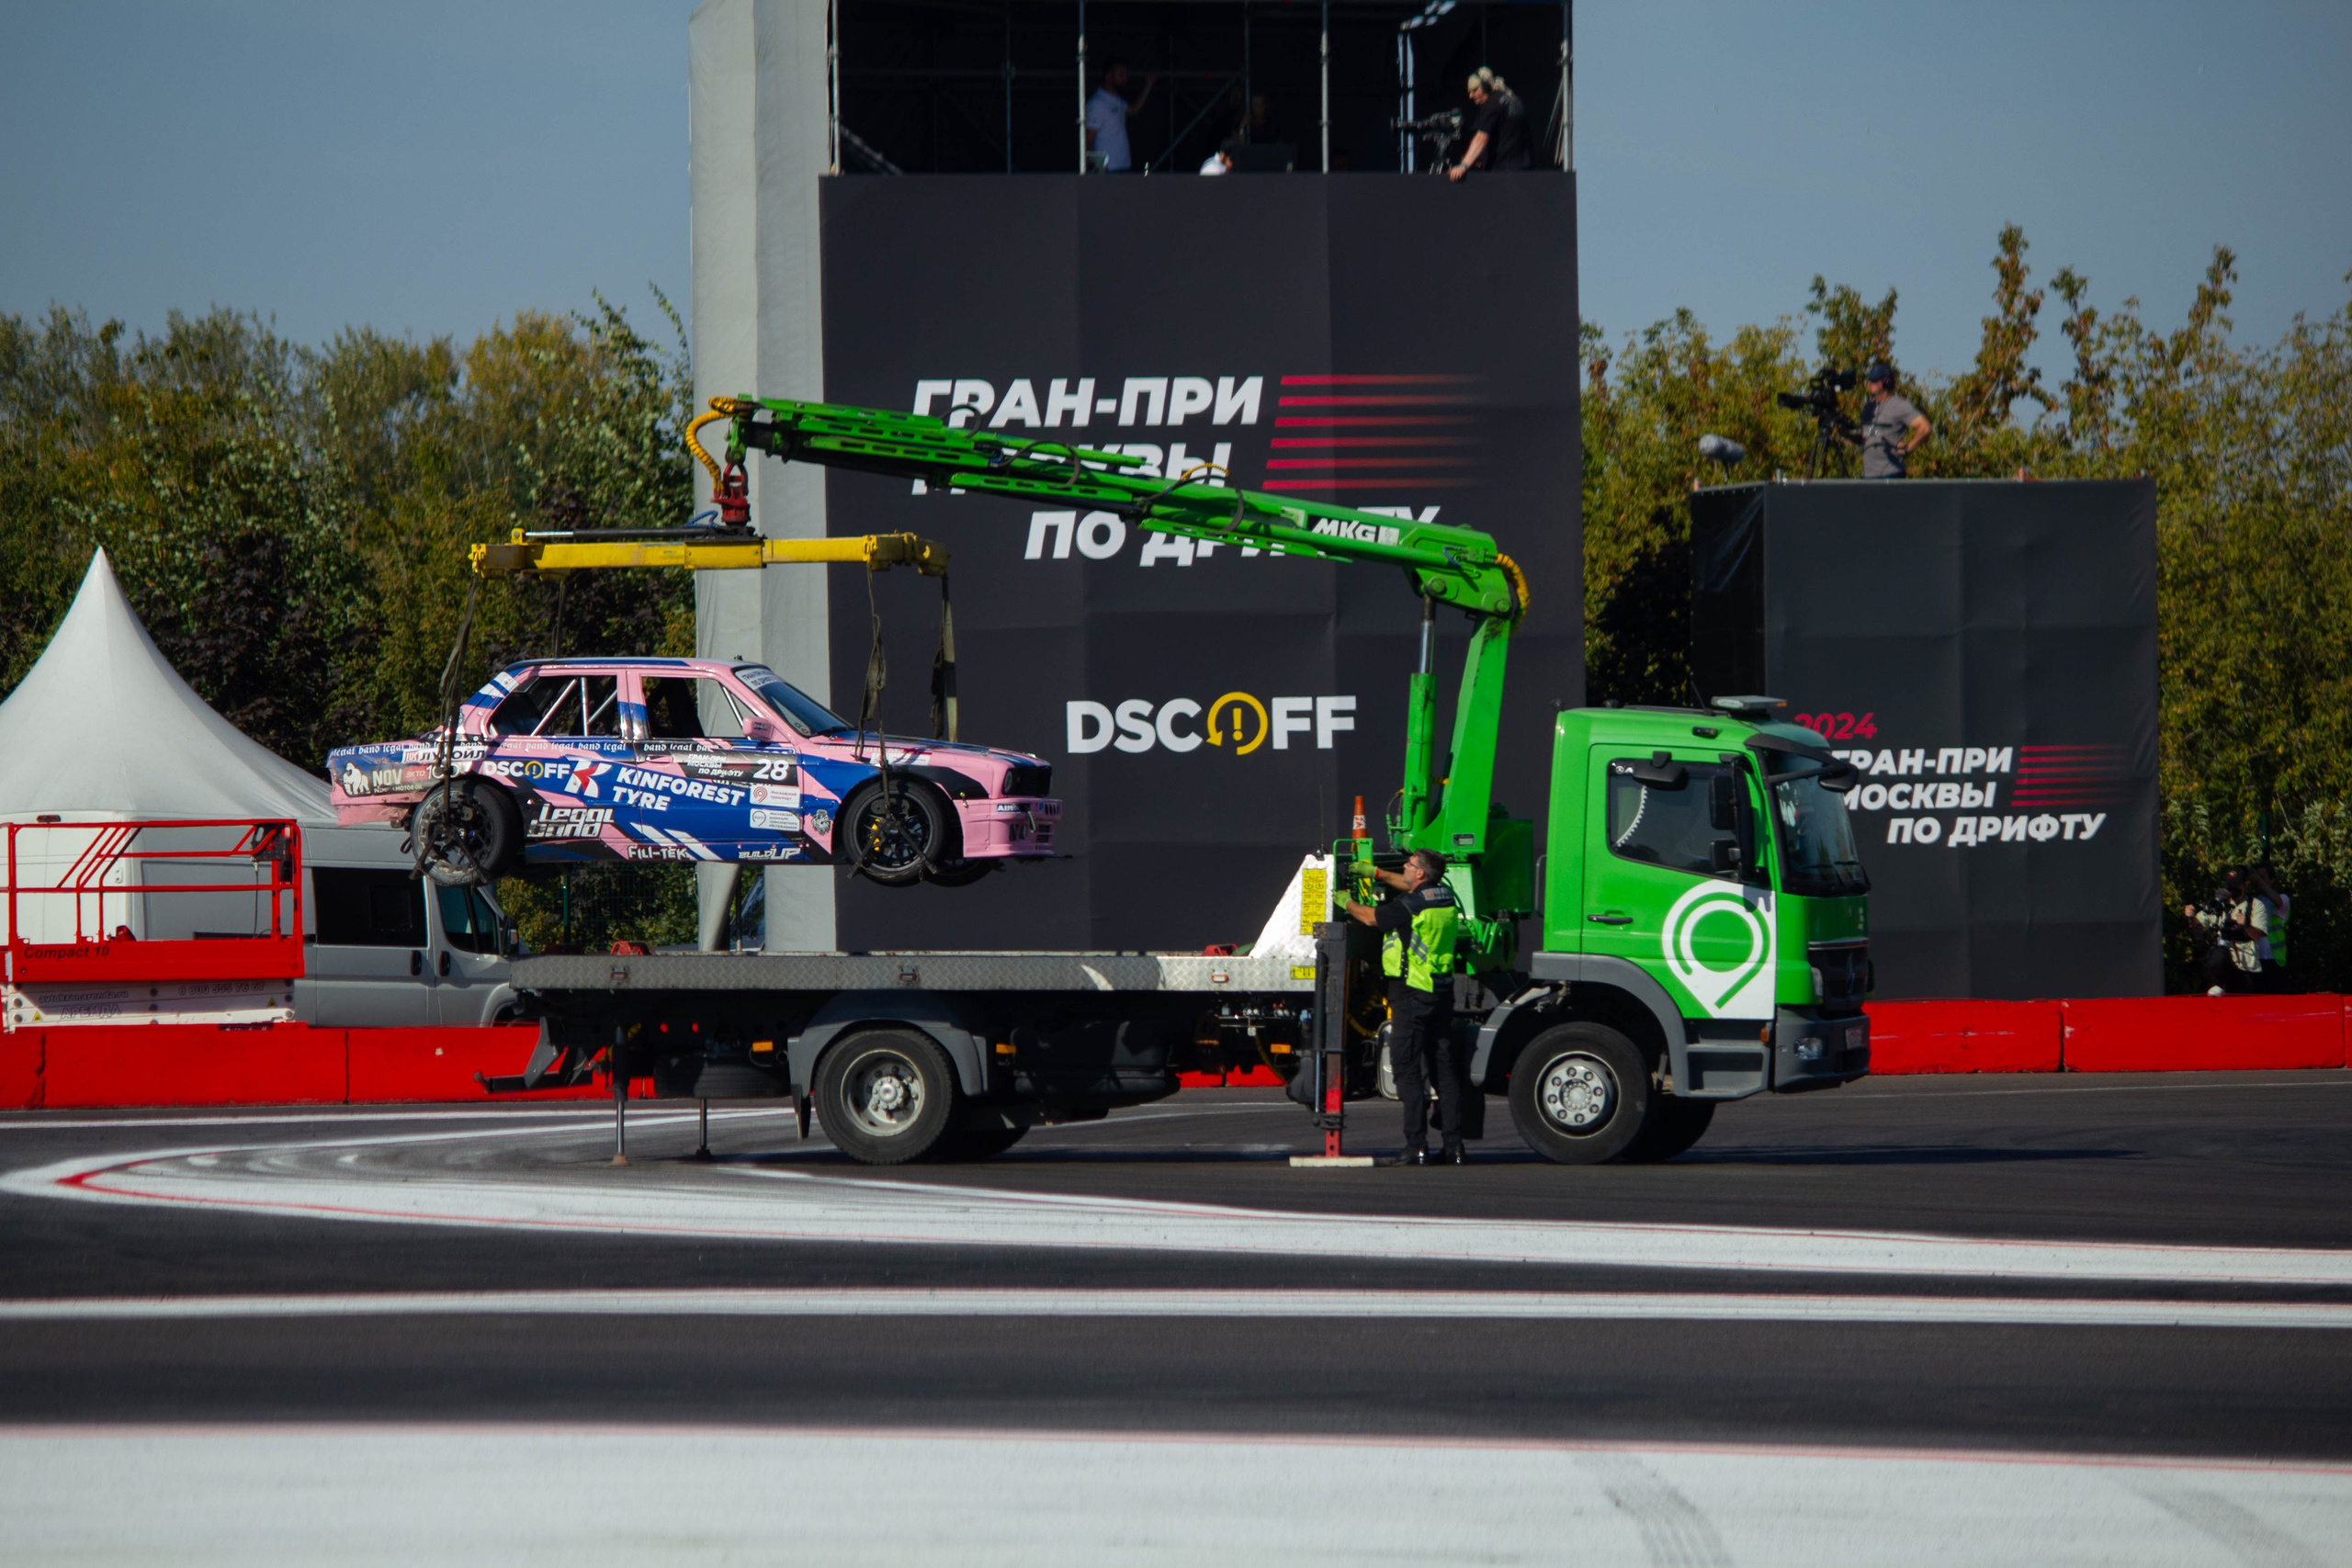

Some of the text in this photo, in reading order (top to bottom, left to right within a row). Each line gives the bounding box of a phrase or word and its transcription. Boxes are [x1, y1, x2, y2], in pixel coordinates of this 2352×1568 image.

[910, 376, 1264, 428] ГРАН-ПРИ
[1024, 511, 1127, 560] ПО
[1312, 517, 1377, 543] MKG
[1794, 713, 1878, 739] 2024
[752, 759, 790, 781] 28
[613, 785, 672, 811] TYRE
[616, 767, 746, 806] KINFOREST
[1887, 813, 2108, 848] ПО ДРИФТУ
[23, 945, 109, 962] Compact 10
[60, 1003, 122, 1021] АРЕНДА
